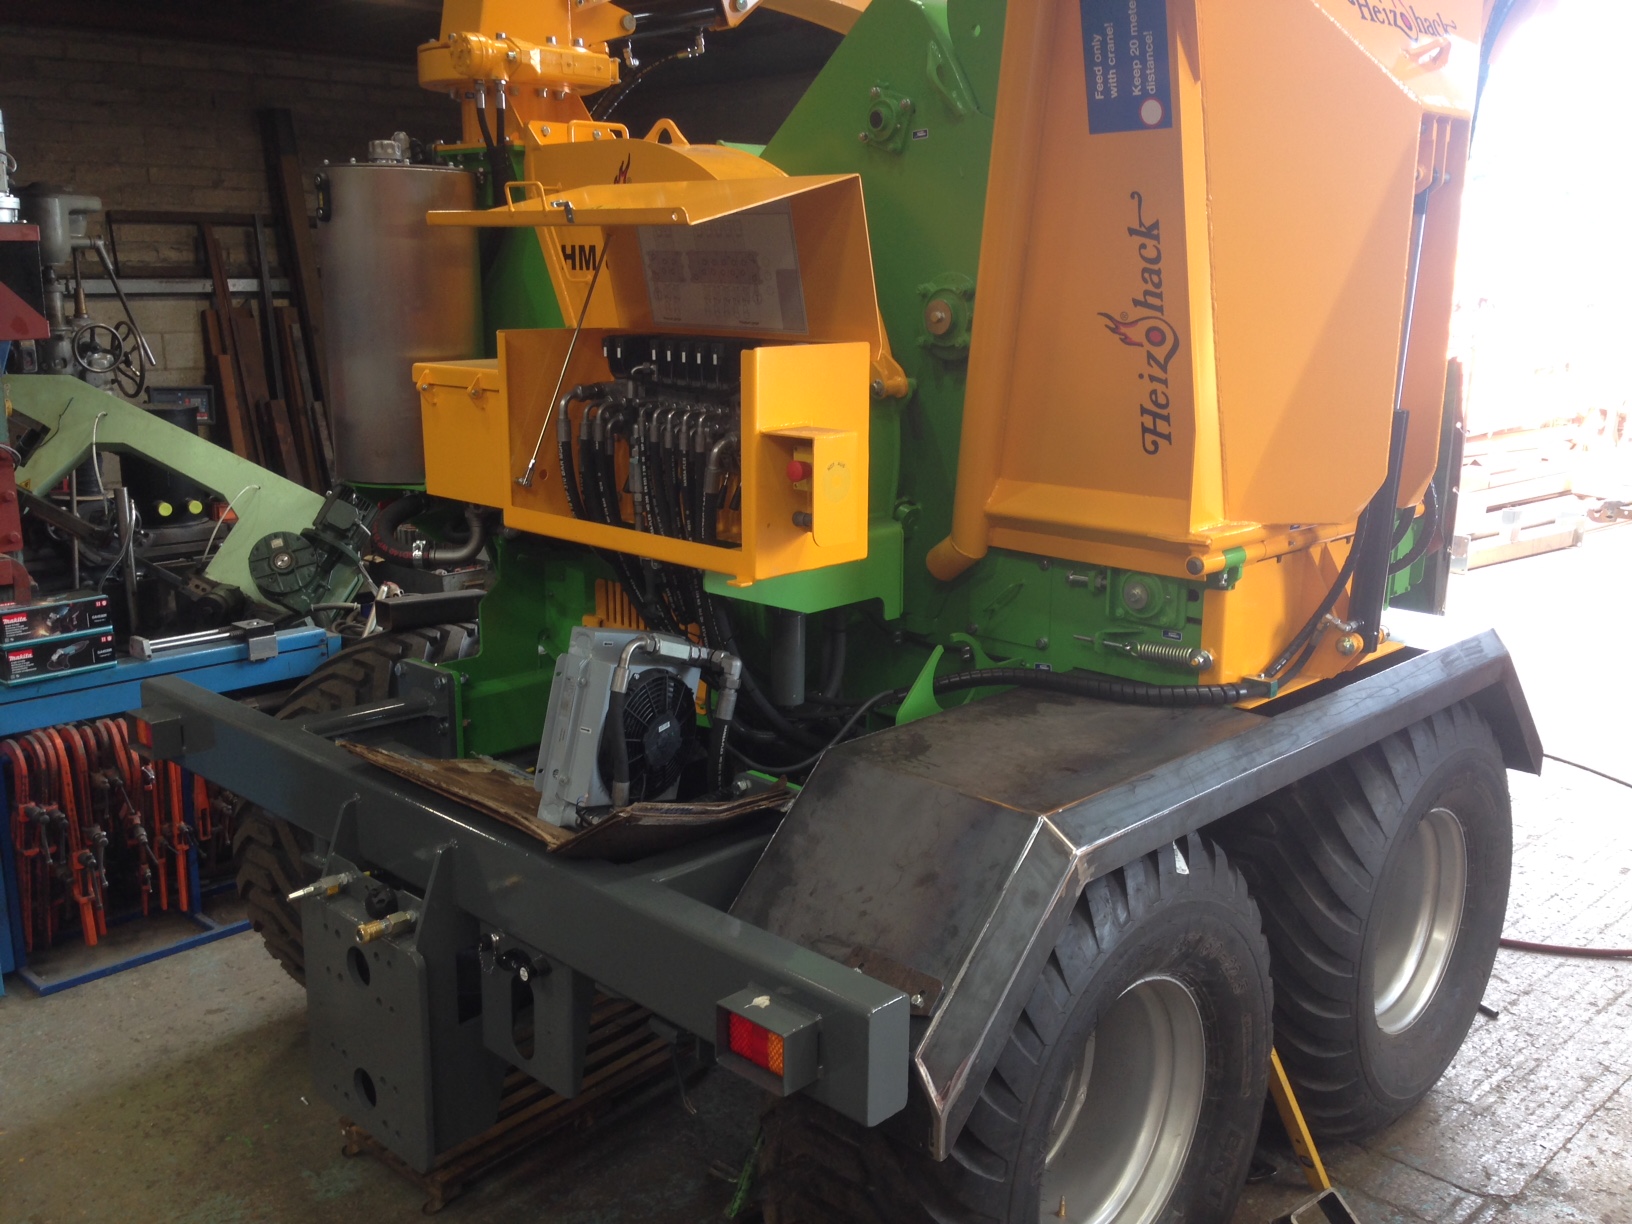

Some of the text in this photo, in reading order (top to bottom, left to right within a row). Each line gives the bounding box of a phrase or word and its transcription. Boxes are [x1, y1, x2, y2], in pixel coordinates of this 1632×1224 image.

[1091, 34, 1104, 100] Feed only
[1104, 22, 1118, 98] with crane!
[1129, 39, 1139, 56] 20
[1143, 31, 1156, 94] distance!
[1131, 59, 1142, 96] Keep
[561, 244, 597, 271] HM
